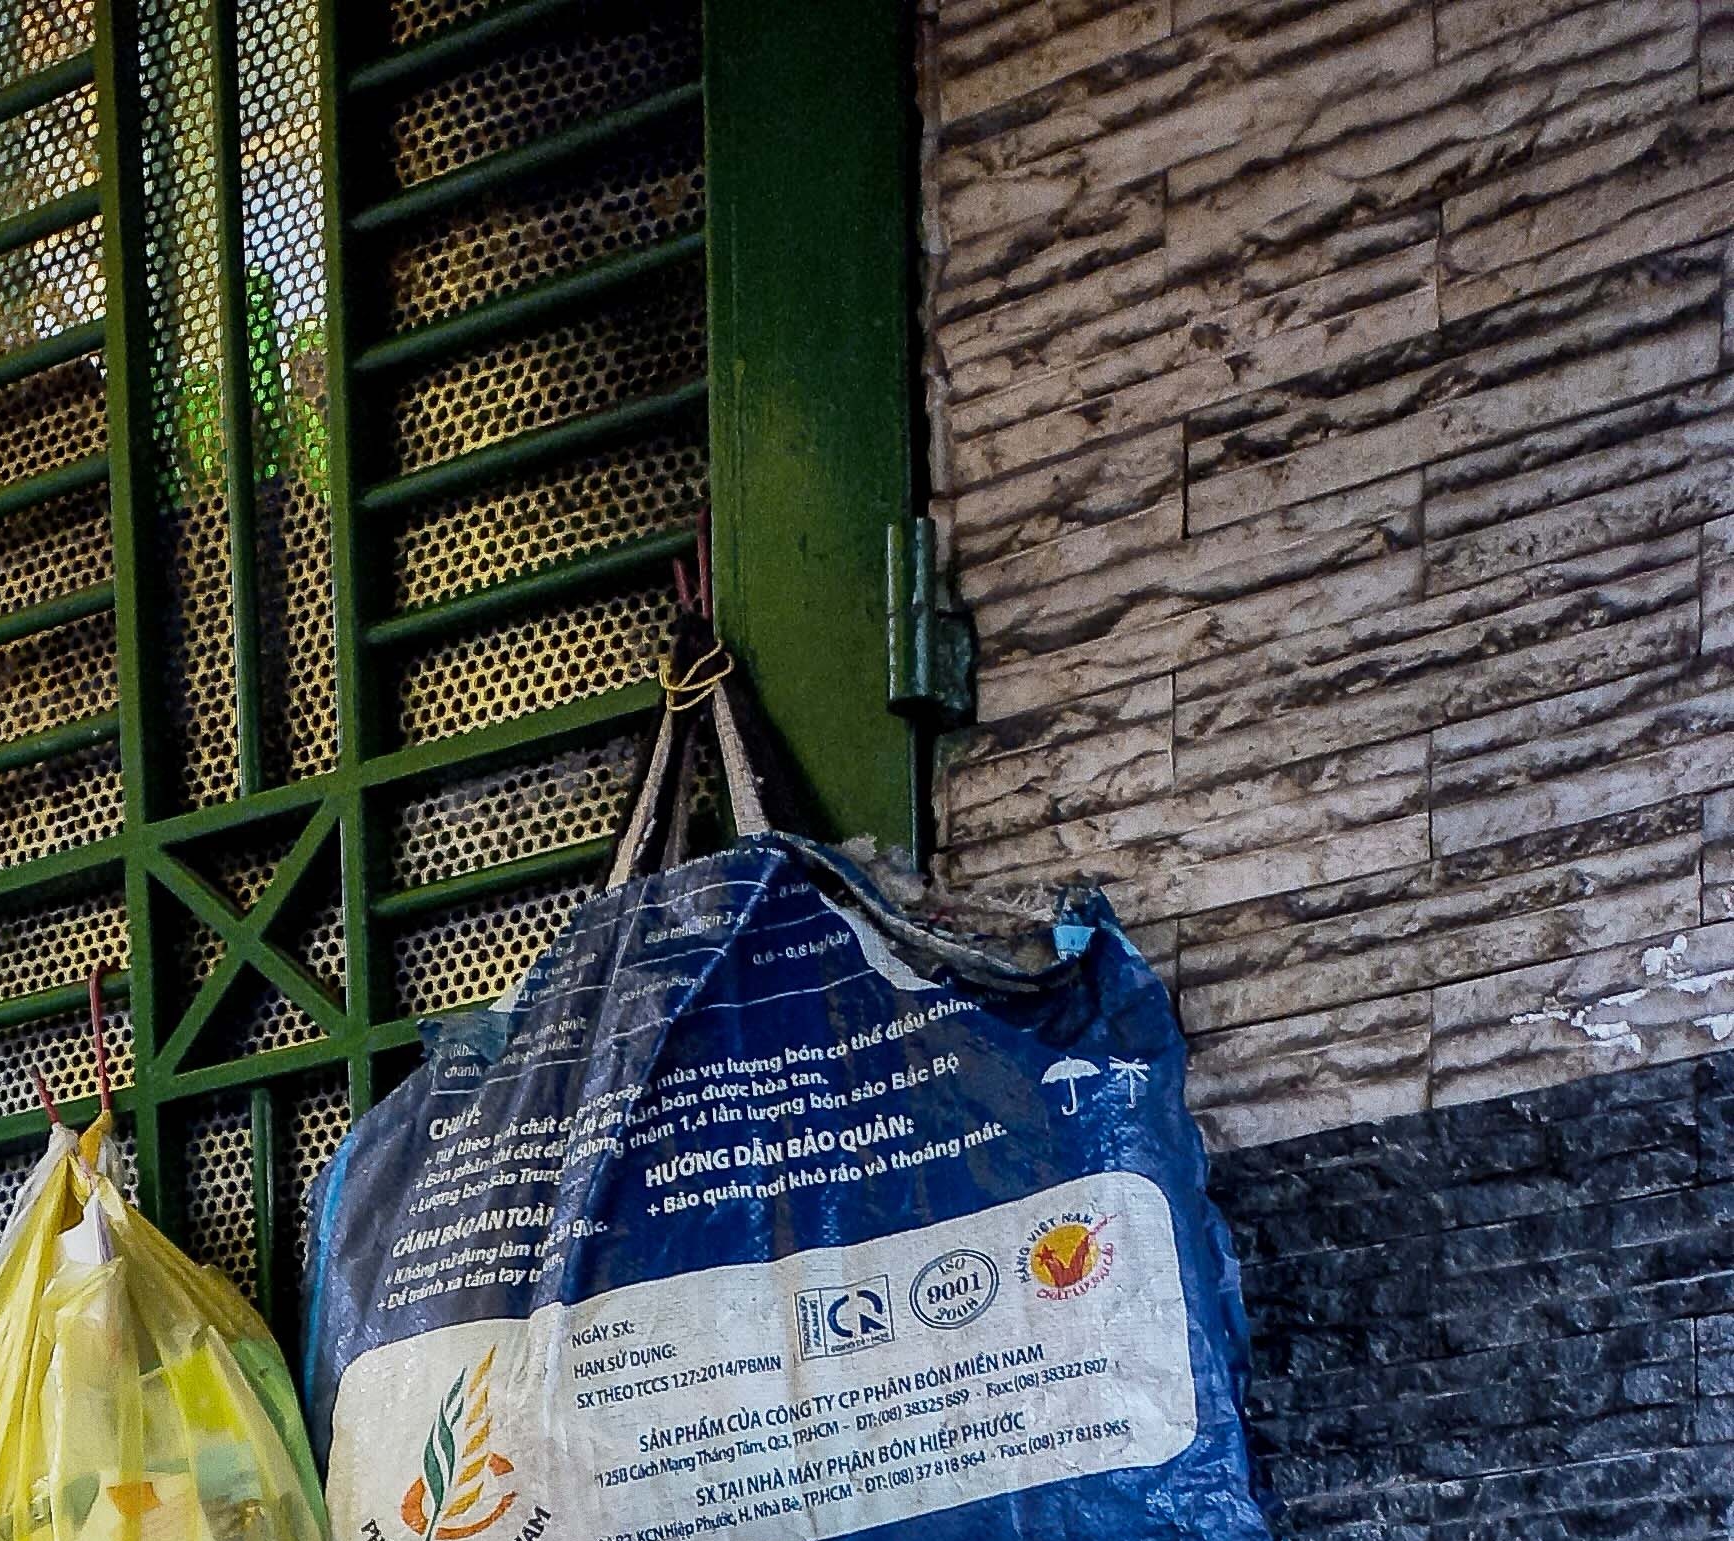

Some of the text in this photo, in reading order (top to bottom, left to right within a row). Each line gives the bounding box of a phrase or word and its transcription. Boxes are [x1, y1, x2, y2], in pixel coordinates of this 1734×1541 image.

[727, 1056, 783, 1078] lượng
[785, 1044, 824, 1064] bón
[661, 1092, 698, 1112] bón
[701, 1083, 750, 1101] được
[790, 1070, 830, 1087] tan.
[680, 1110, 708, 1132] 1,4
[747, 1097, 806, 1122] lượng
[810, 1092, 848, 1110] bón
[932, 1052, 960, 1076] Bộ
[645, 1149, 730, 1187] HƯỚNG
[734, 1137, 783, 1167] DẪN
[787, 1127, 835, 1158] BẢO
[839, 1113, 915, 1152] QUẢN:
[663, 1191, 699, 1214] Bảo
[703, 1180, 753, 1207] quản
[788, 1166, 827, 1190] khô
[830, 1162, 863, 1183] ráo
[865, 1154, 888, 1177] và
[890, 1137, 960, 1170] thoáng
[964, 1121, 1008, 1149] mát.
[498, 1267, 527, 1287] tay
[937, 1256, 966, 1277] ISO
[925, 1271, 984, 1305] 9001
[571, 1319, 635, 1349] NGÀY SX:
[573, 1343, 678, 1381] HẠN SỬ DỤNG:
[577, 1354, 782, 1410] SX THEO TCCS 127:2014/PBMN
[639, 1343, 1044, 1453] SẢN PHẨM CỦA CÔNG TY CP PHÂN BÓN MIỀN NAM
[660, 1456, 696, 1477] Mạng
[695, 1445, 736, 1467] Tháng
[696, 1411, 1026, 1508] SX TẠI NHÀ MÁY PHÂN BÓN HIỆP PHƯỚC
[753, 1499, 781, 1521] Nhà
